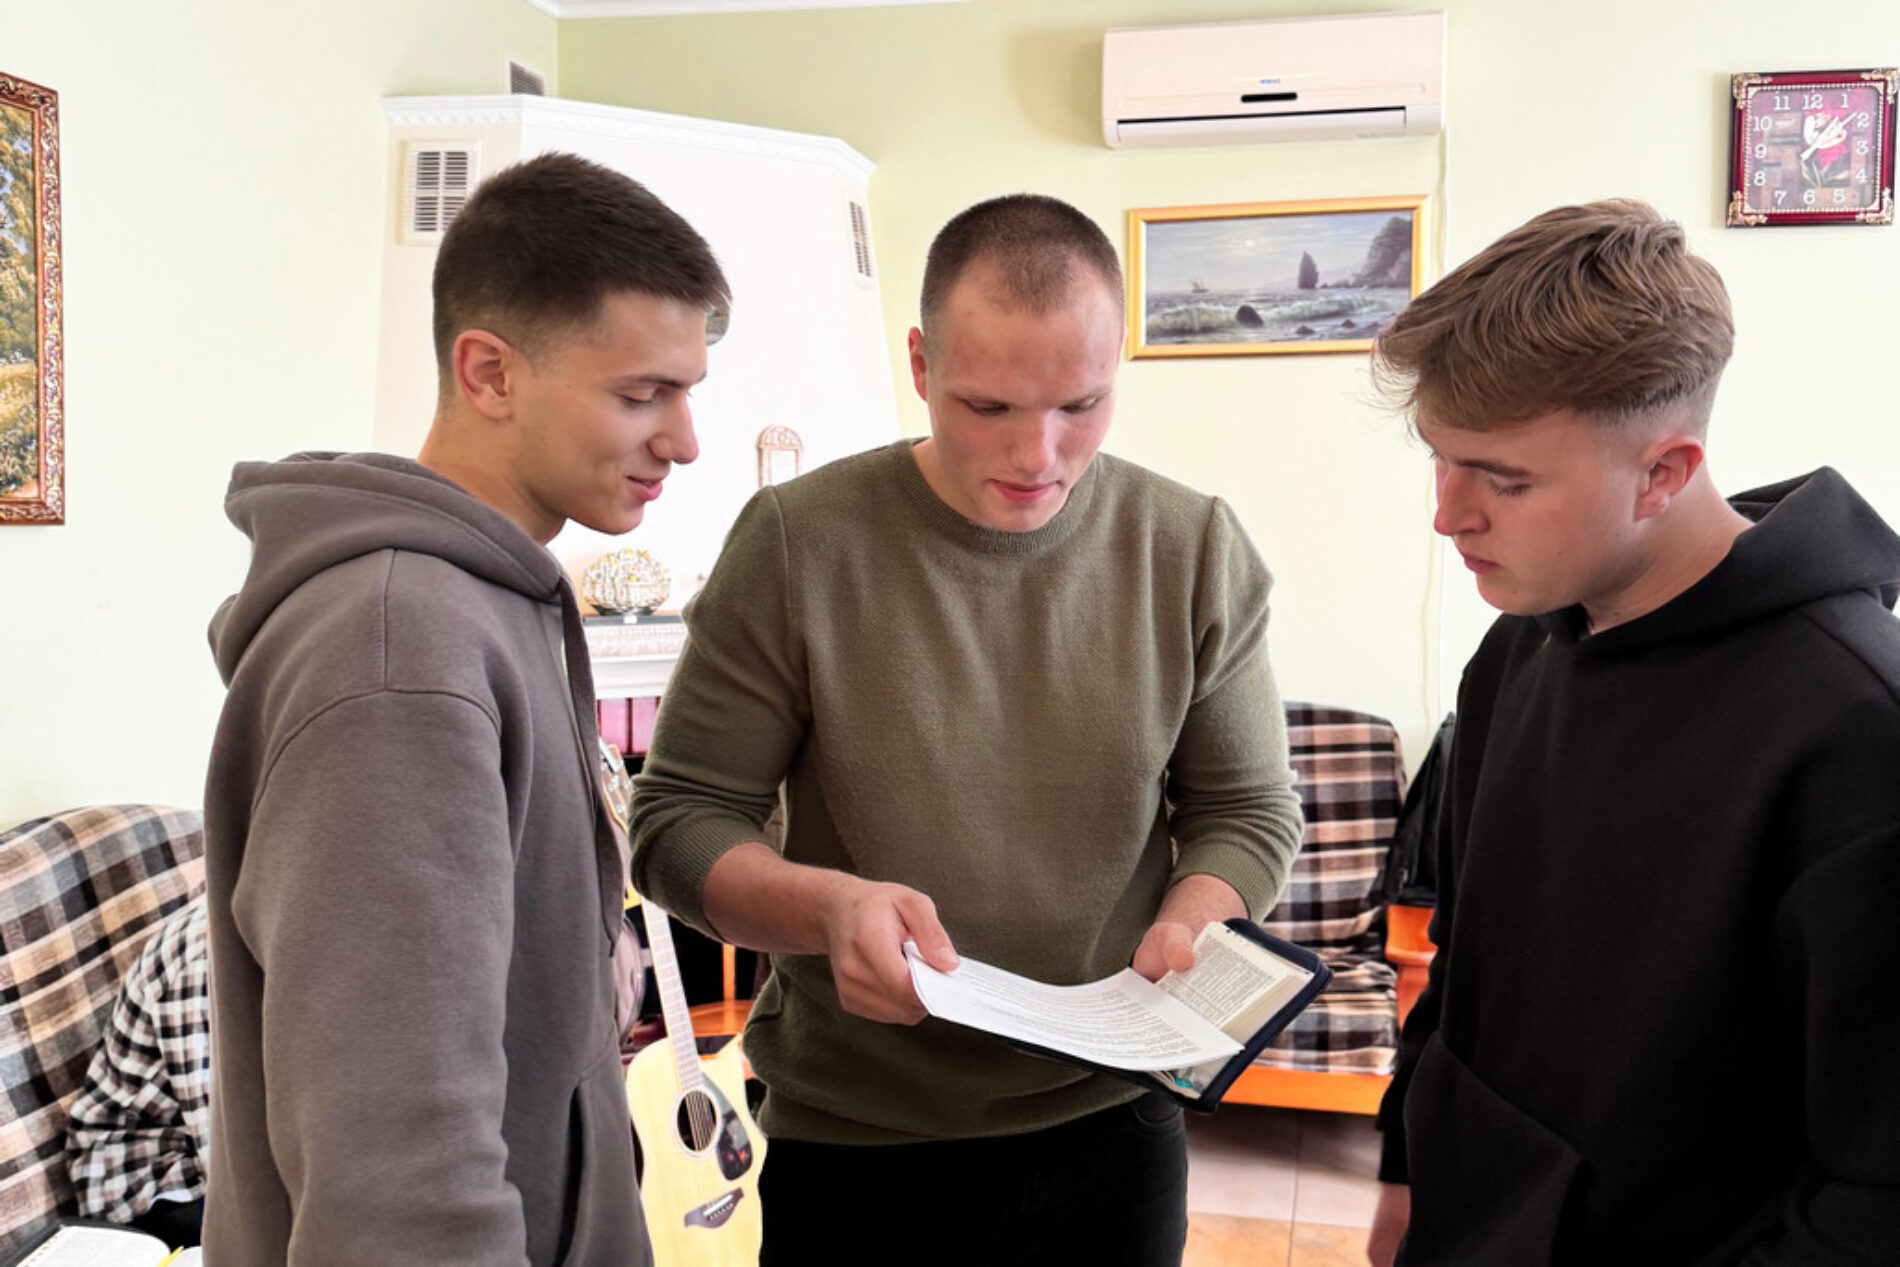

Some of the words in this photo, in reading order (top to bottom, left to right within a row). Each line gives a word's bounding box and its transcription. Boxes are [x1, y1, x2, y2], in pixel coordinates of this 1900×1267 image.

[1774, 95, 1791, 111] 11
[1802, 94, 1823, 110] 12
[1840, 93, 1849, 108] 1
[1753, 116, 1772, 131] 10
[1856, 112, 1869, 128] 2
[1754, 144, 1767, 158] 9
[1856, 140, 1868, 155] 3
[1753, 171, 1766, 186] 8
[1856, 168, 1868, 183] 4
[1774, 190, 1787, 205] 7
[1803, 189, 1816, 204] 6
[1832, 189, 1846, 203] 5
